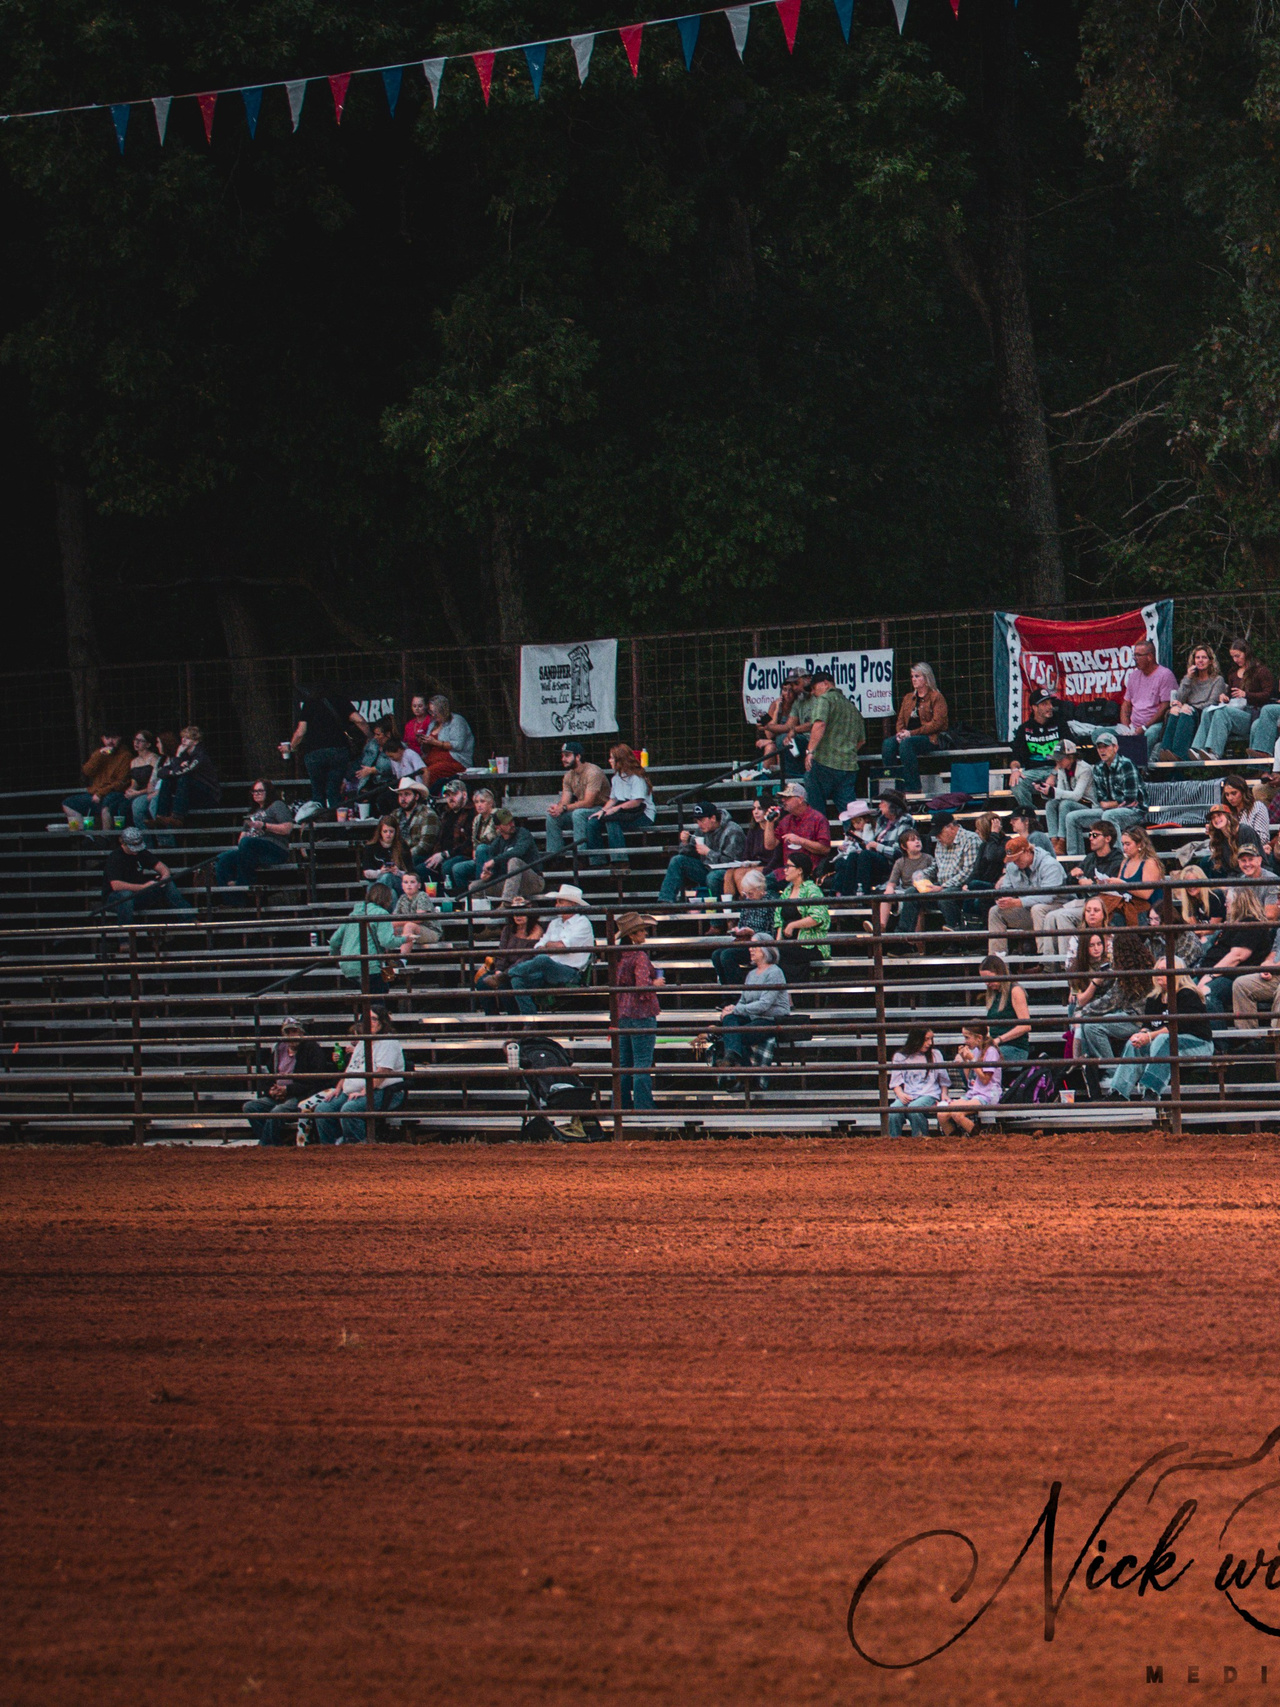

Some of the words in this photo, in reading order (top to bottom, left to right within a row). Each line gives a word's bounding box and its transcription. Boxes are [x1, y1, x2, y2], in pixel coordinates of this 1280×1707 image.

[747, 661, 796, 690] Carolin
[860, 655, 892, 683] Pros
[1029, 655, 1055, 690] TSC
[1065, 669, 1125, 696] SUPPLY
[866, 689, 892, 699] Gutters
[868, 703, 890, 713] Fascia
